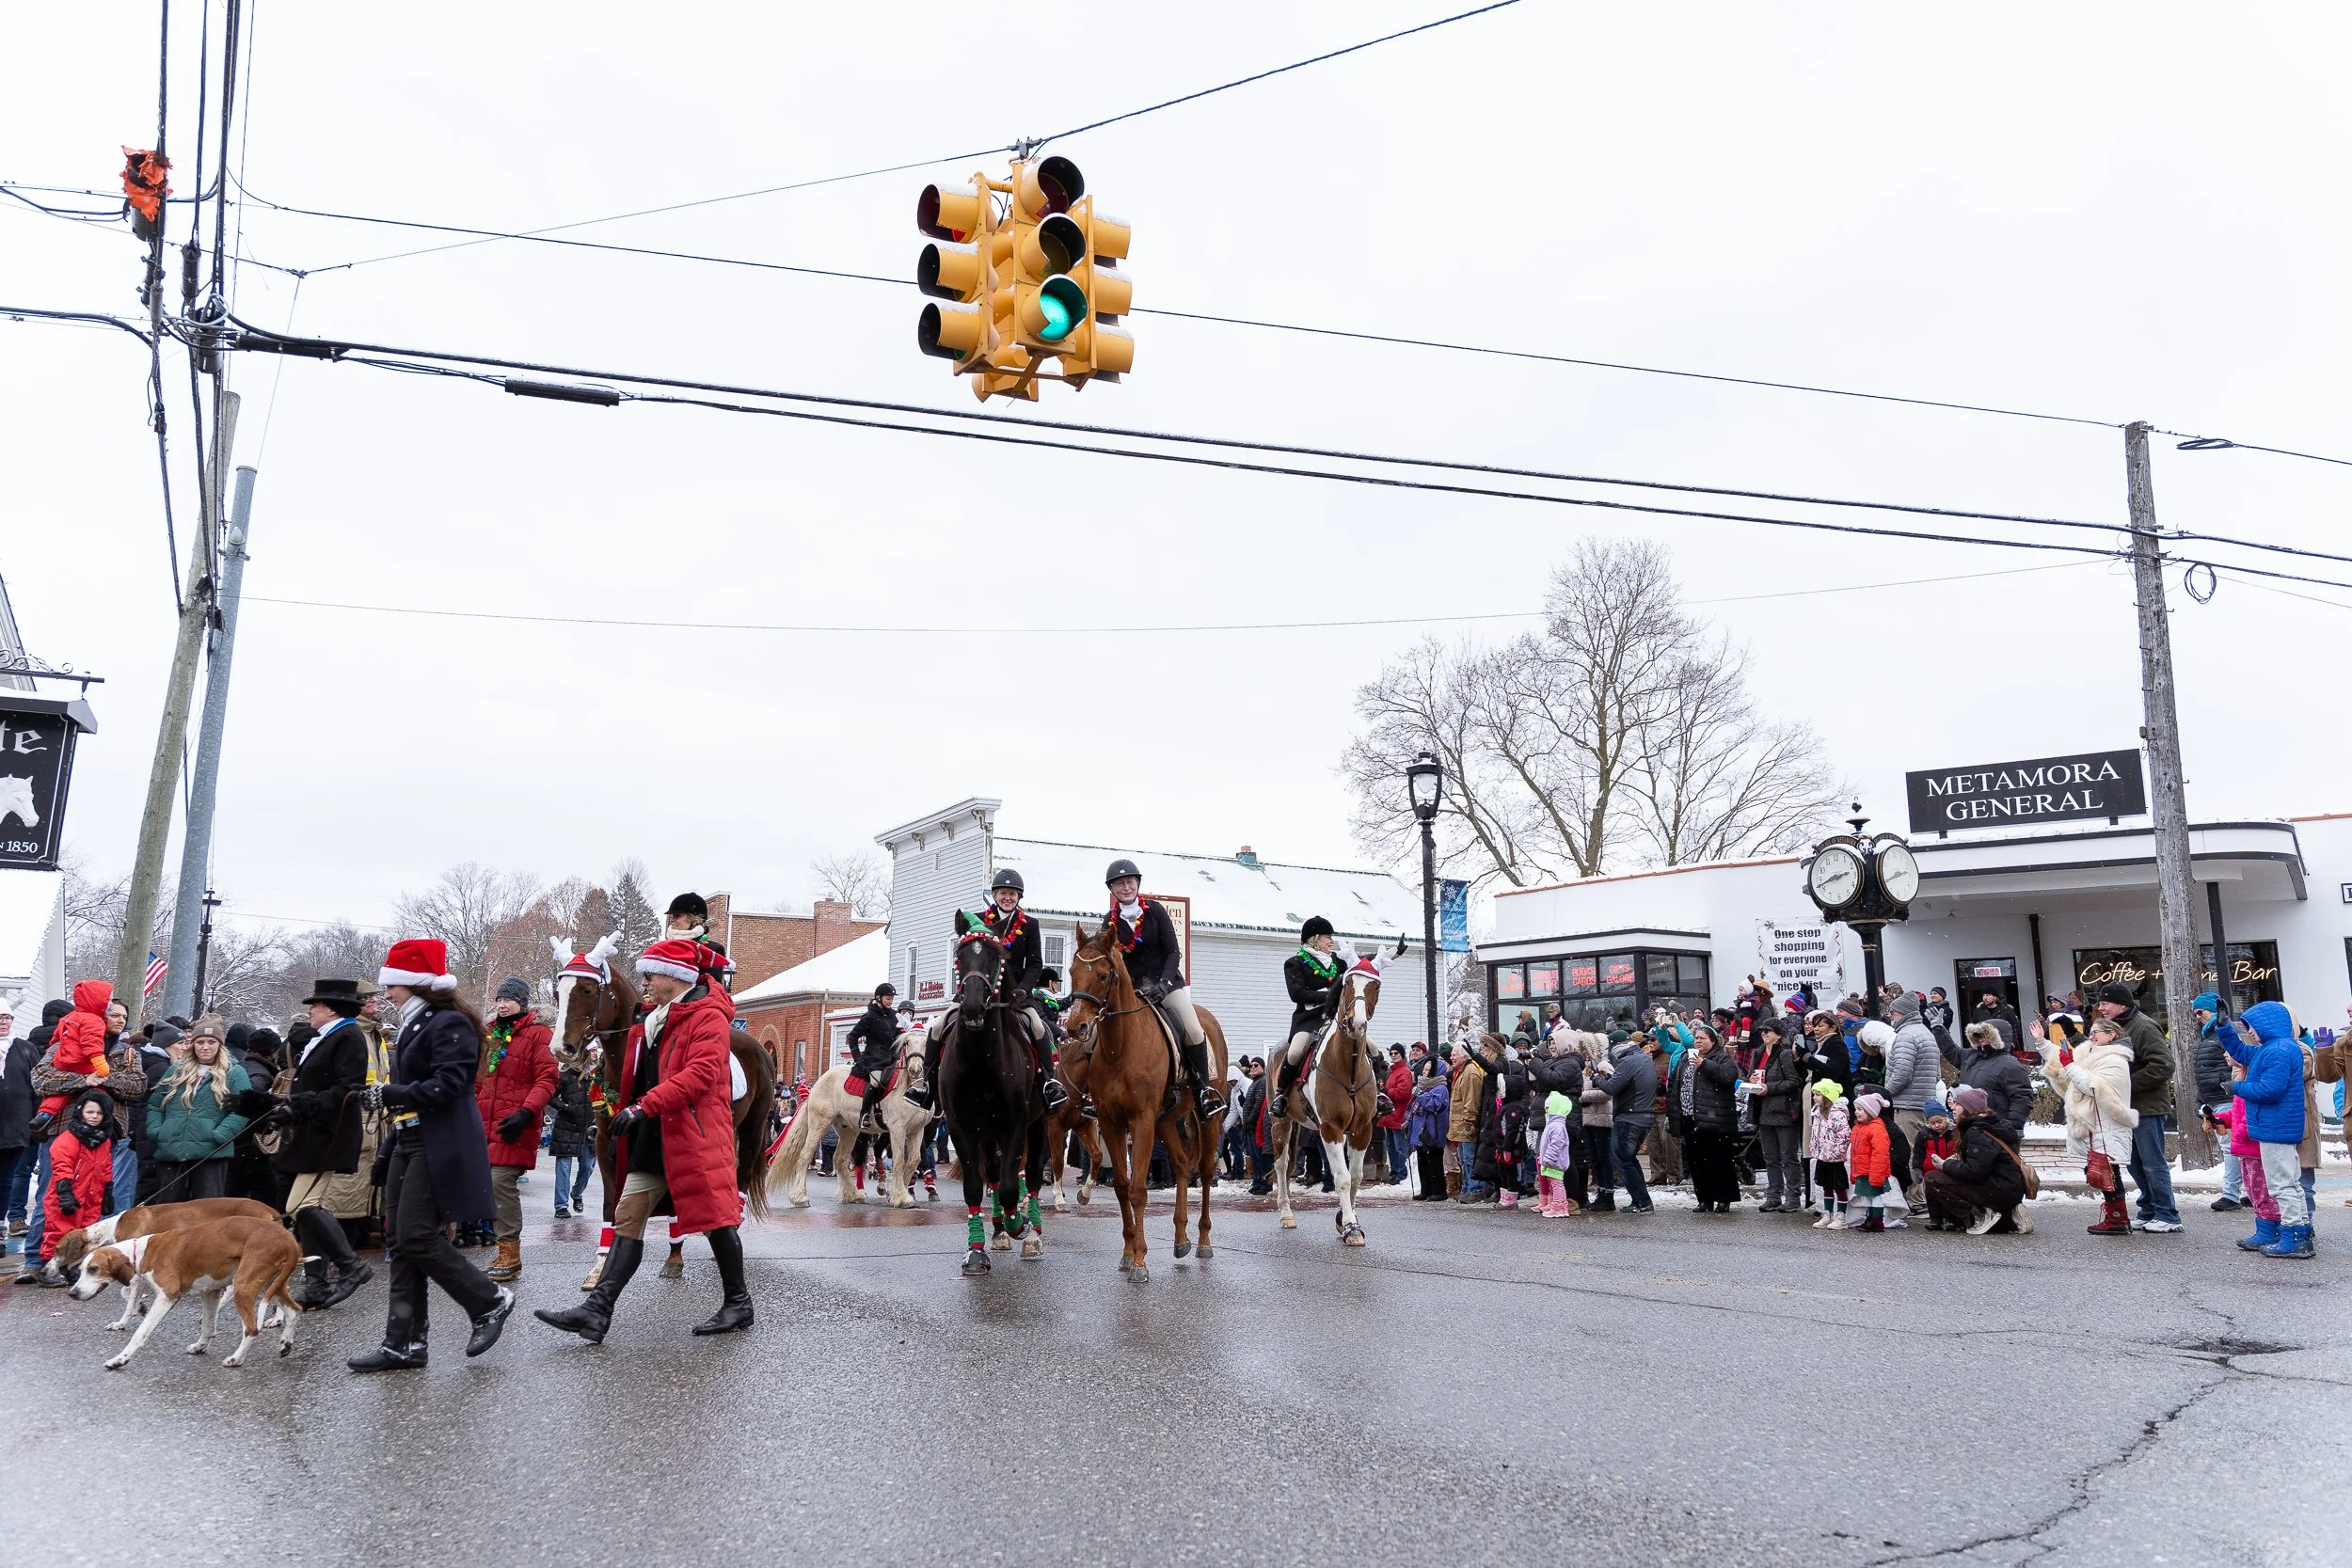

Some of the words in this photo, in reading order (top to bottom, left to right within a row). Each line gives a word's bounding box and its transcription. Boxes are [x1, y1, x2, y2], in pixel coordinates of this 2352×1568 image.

[1926, 759, 2122, 798] METAMORA
[1946, 789, 2105, 821] GENERAL
[6, 840, 39, 854] 1850
[1773, 929, 1795, 939] One
[1797, 928, 1821, 939] stop
[1773, 941, 1825, 952] shopping
[1769, 956, 1782, 965] for
[1784, 955, 1827, 965] everyone
[1571, 967, 1597, 977] BOOKS
[1609, 963, 1631, 974] GIFTS
[1780, 969, 1793, 978] on
[1794, 968, 1819, 978] your
[2079, 961, 2146, 985] Coffee
[2230, 959, 2278, 983] Bar
[1572, 975, 1597, 987] CARDS
[1606, 972, 1635, 985] GALORE
